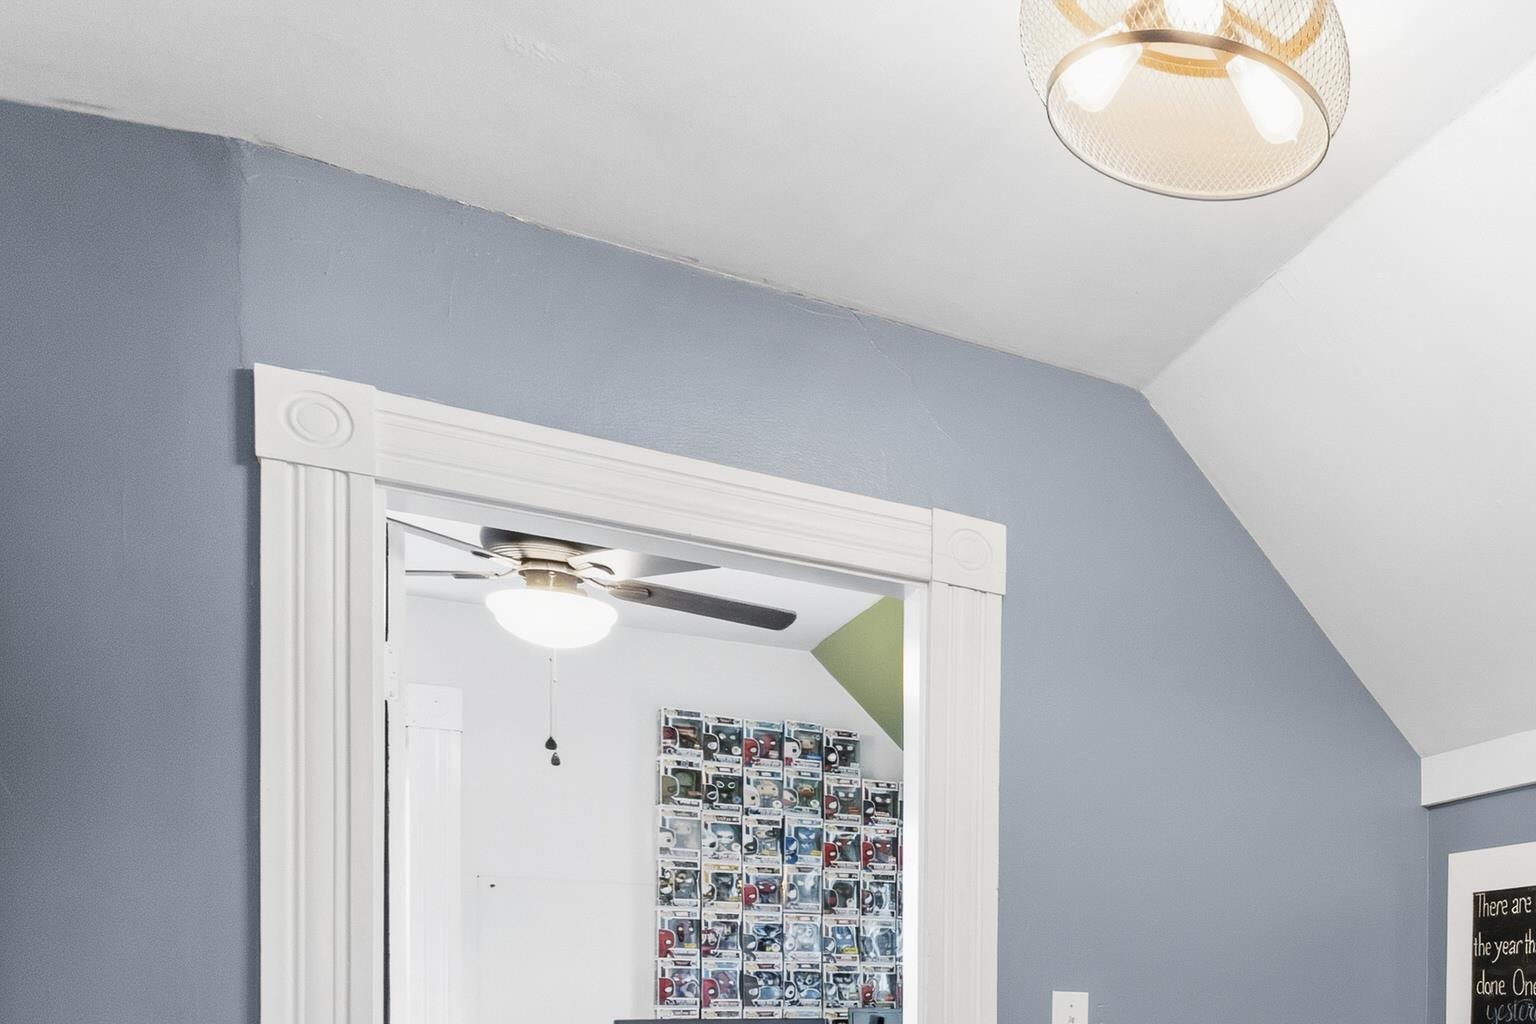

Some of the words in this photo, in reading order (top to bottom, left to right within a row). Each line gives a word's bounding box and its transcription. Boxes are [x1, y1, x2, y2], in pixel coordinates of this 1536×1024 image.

[1475, 892, 1508, 918] There
[1511, 895, 1532, 914] are
[1473, 931, 1491, 957] the
[1491, 938, 1524, 964] year
